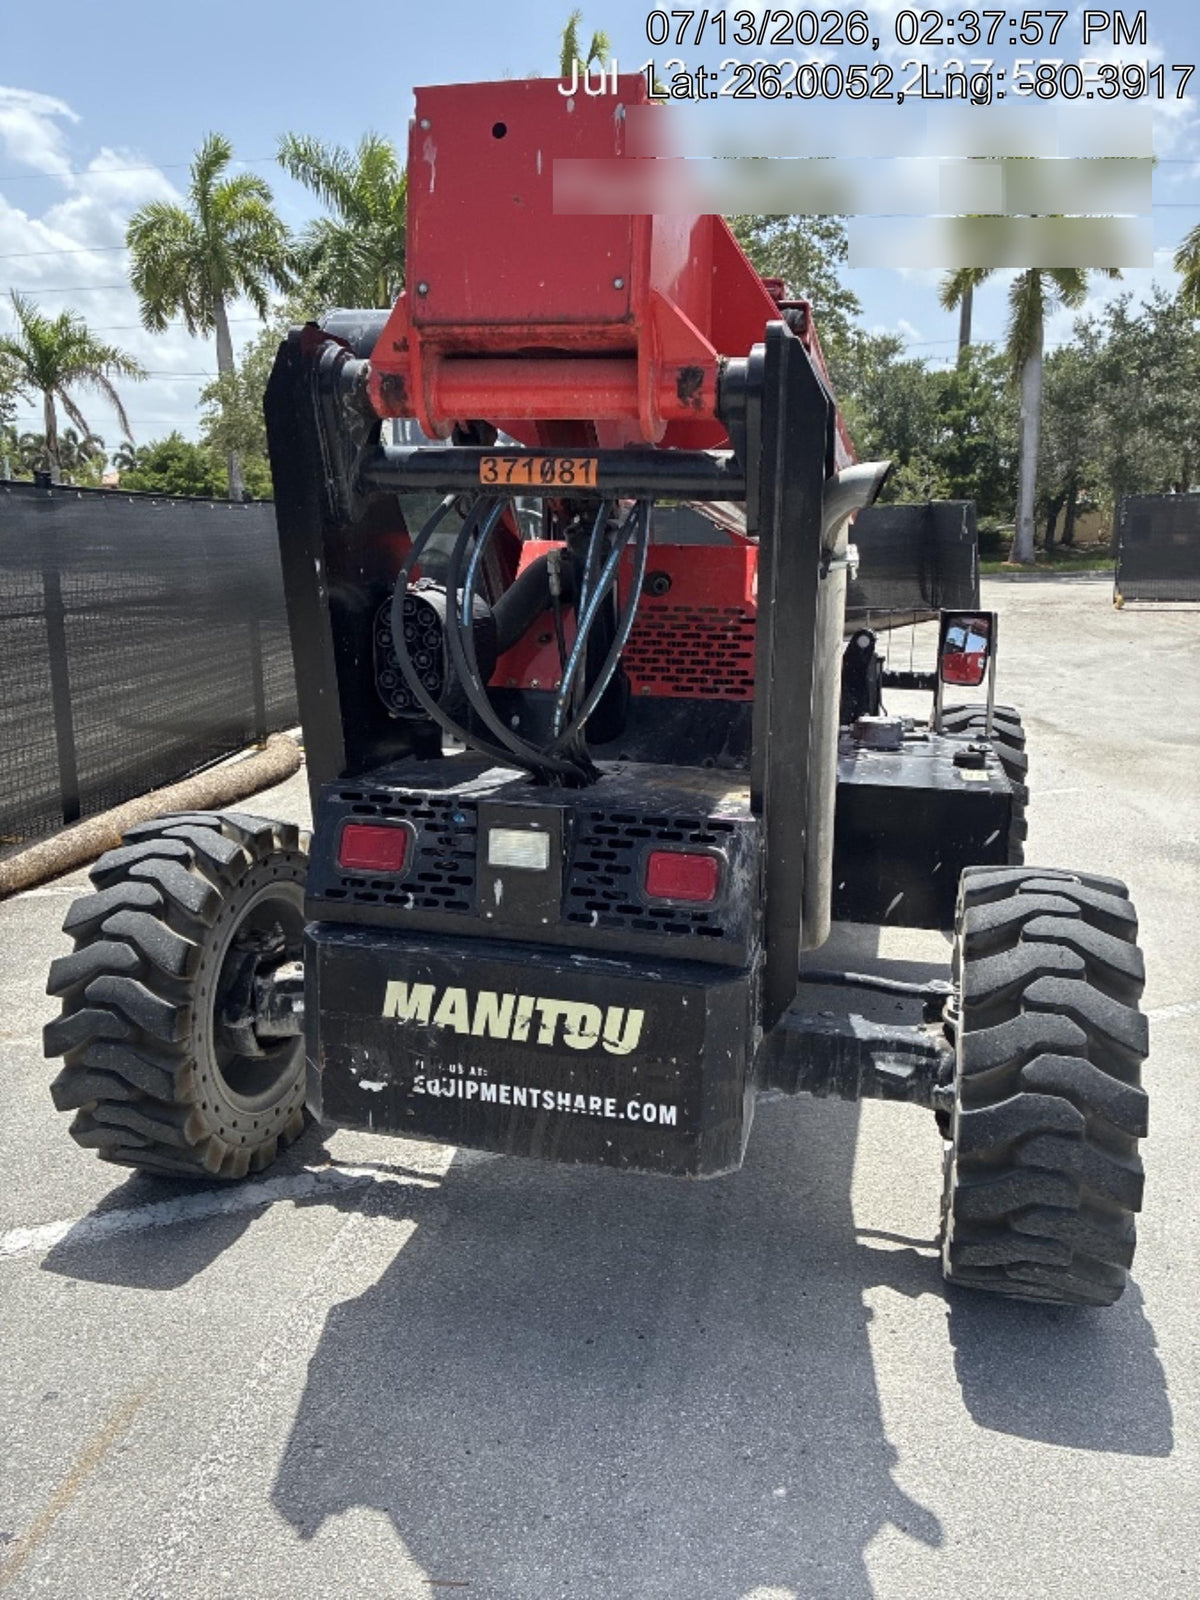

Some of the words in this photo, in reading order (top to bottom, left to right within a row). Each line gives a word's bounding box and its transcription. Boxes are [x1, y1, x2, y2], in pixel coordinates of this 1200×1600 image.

[483, 457, 592, 484] 371081
[382, 981, 644, 1055] MANITOU
[413, 1075, 677, 1126] EQUIPMENTSHARE.COM
